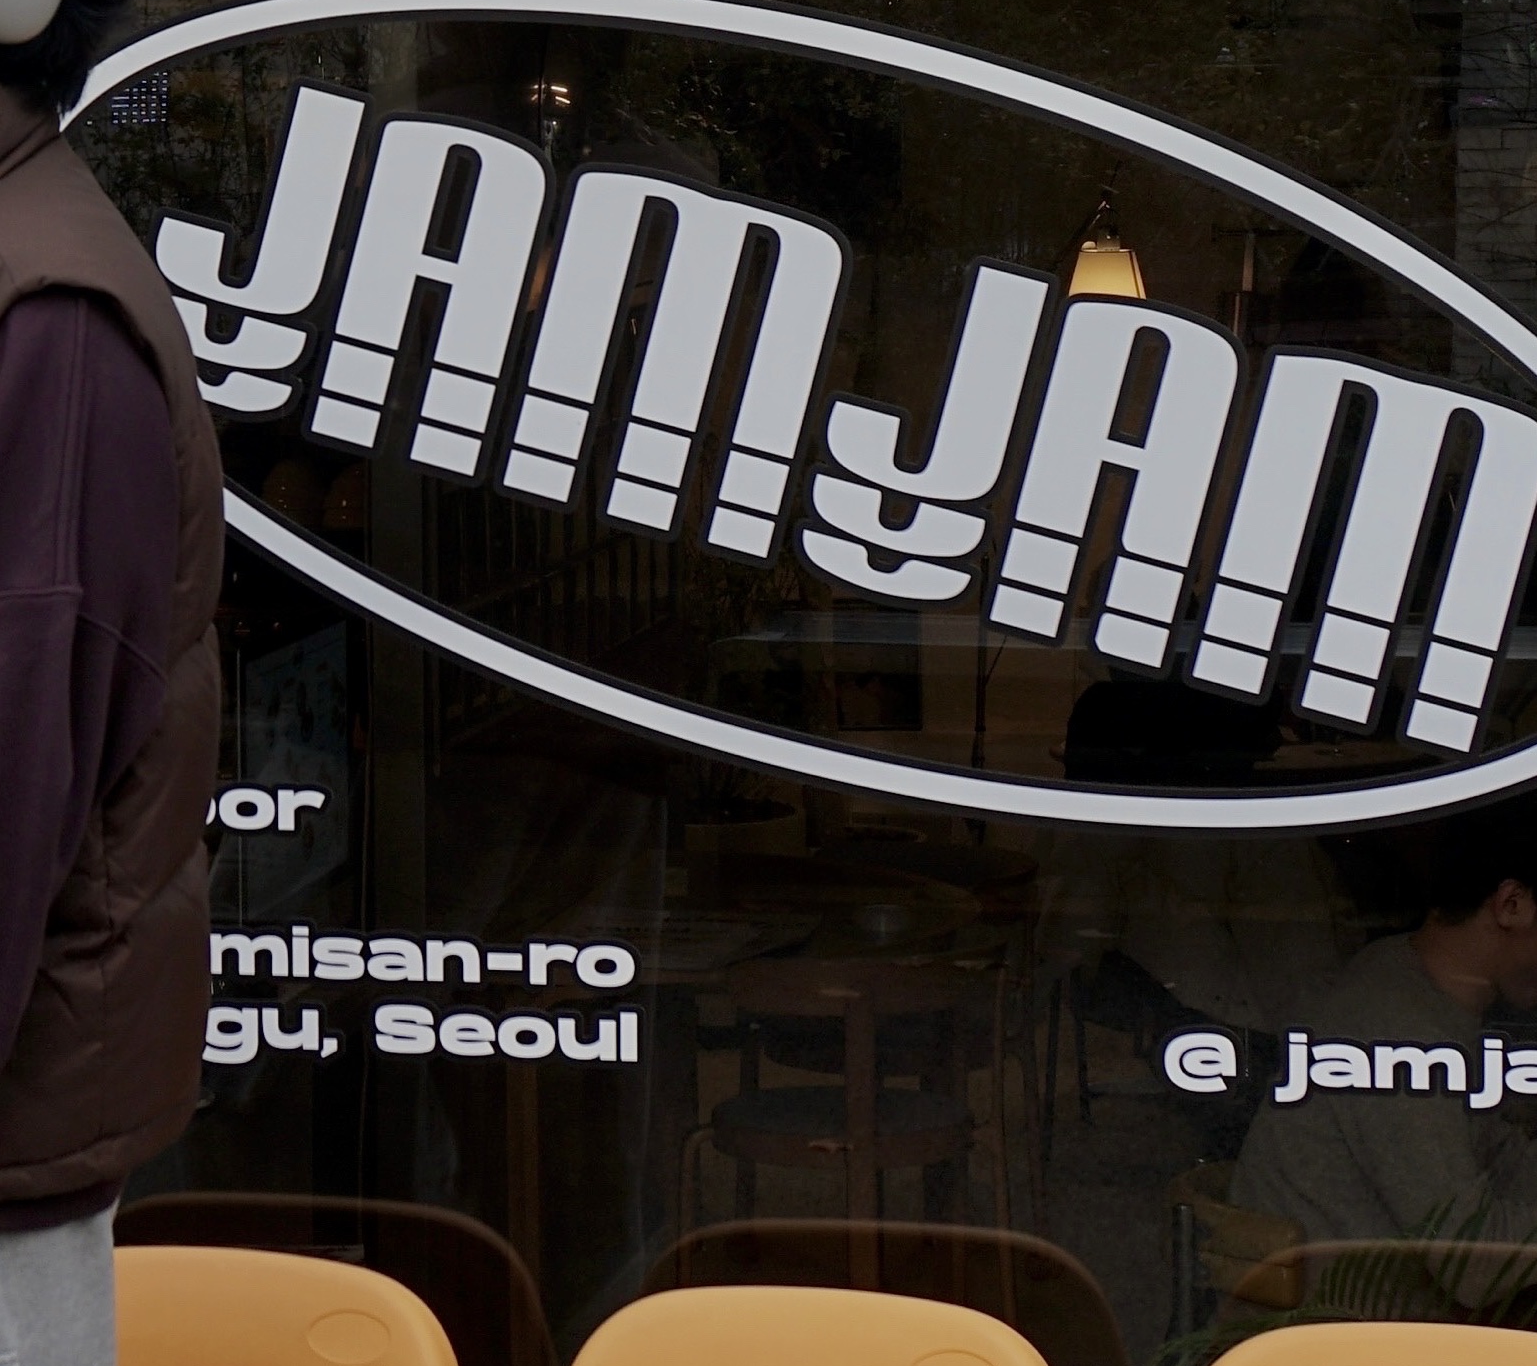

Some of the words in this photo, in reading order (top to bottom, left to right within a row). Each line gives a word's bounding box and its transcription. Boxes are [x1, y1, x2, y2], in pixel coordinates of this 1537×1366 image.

[205, 787, 326, 832] or
[209, 925, 636, 988] misan-ro
[202, 1005, 339, 1065] gu,
[374, 1004, 639, 1063] Seoul
